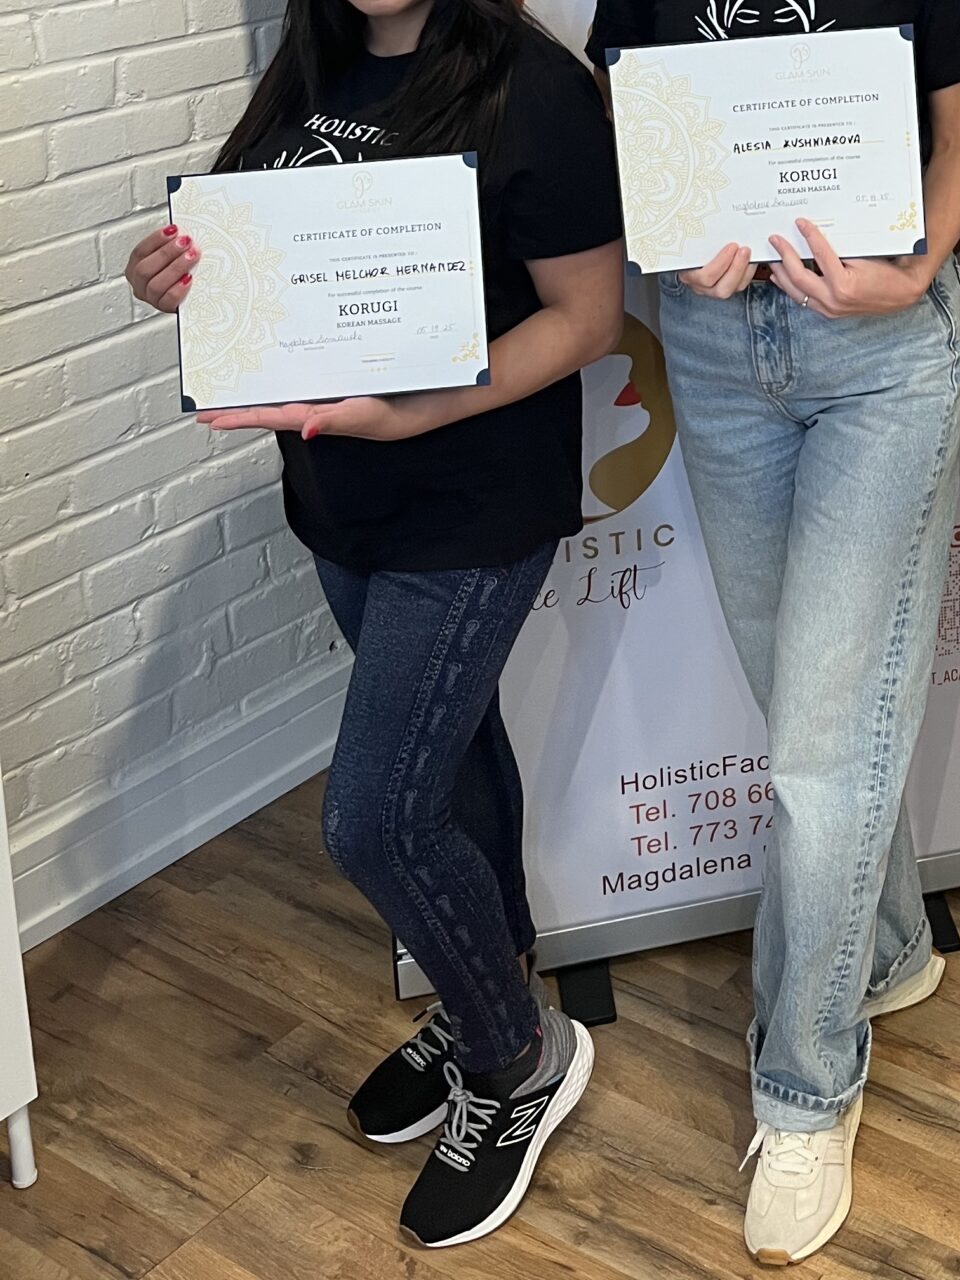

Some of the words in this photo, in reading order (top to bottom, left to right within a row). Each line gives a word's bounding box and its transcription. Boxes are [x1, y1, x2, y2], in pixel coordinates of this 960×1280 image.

[732, 100, 797, 113] CERTIFICATE
[800, 98, 812, 107] OF
[815, 94, 880, 105] COMPLETION
[733, 140, 771, 154] ALESIA
[779, 168, 838, 183] KORUGI
[778, 187, 806, 195] KOREAN
[808, 185, 840, 193] MASSAGE
[293, 230, 358, 242] CERTIFICATE
[360, 228, 374, 237] OF
[376, 222, 442, 236] COMPLETION
[291, 272, 328, 285] GRISEL
[335, 266, 389, 282] MELCHOR
[338, 300, 398, 316] KORUGI
[336, 320, 366, 329] KOREAN
[367, 317, 402, 327] MASSAGE
[565, 524, 675, 562] ISTIC
[576, 561, 666, 609] Lift
[620, 755, 769, 795] HolisticFac
[629, 799, 676, 824] Tel.
[688, 787, 737, 813] 708
[748, 782, 774, 804] 66
[630, 831, 677, 856] Tel.
[689, 819, 738, 846] 773
[602, 852, 752, 895] Magdalena
